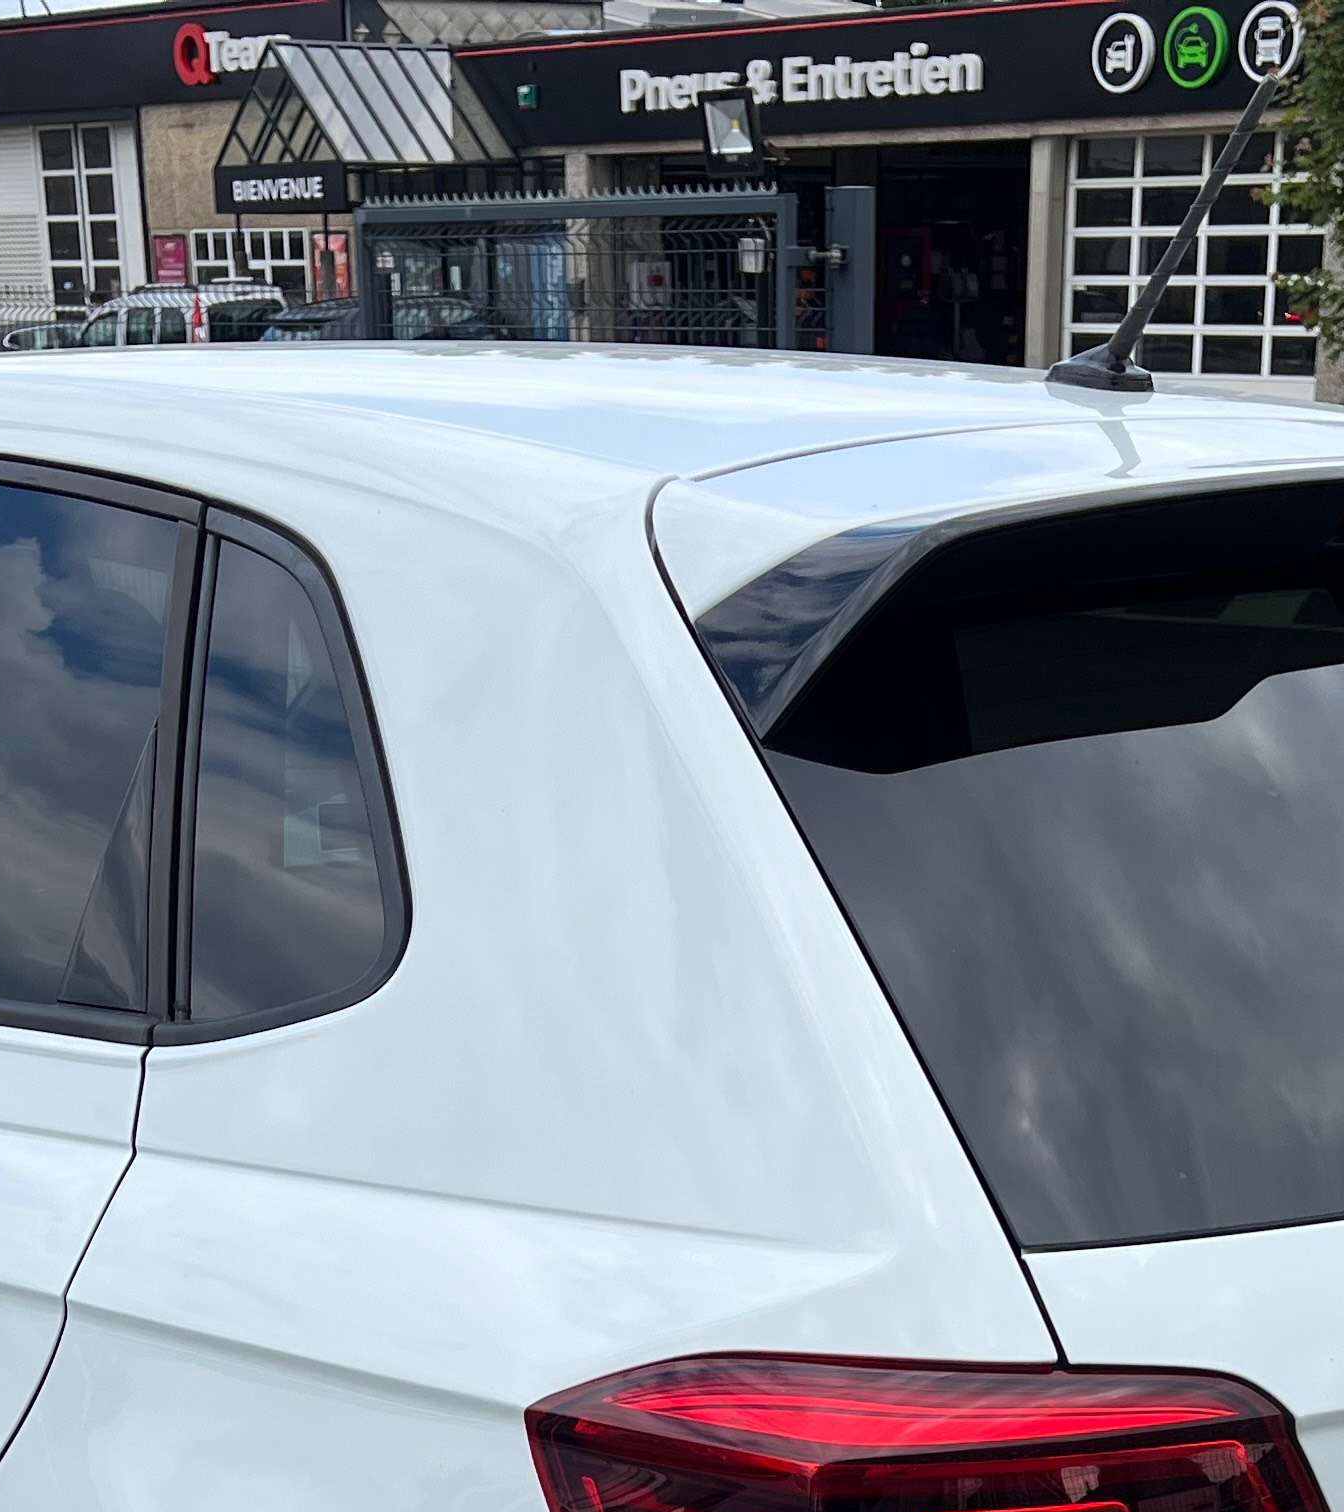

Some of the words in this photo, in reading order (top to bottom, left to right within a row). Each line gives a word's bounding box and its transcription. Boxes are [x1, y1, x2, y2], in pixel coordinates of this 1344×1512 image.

[745, 59, 779, 105] &
[782, 41, 984, 103] Entretien
[232, 176, 324, 202] BIENVENUE
